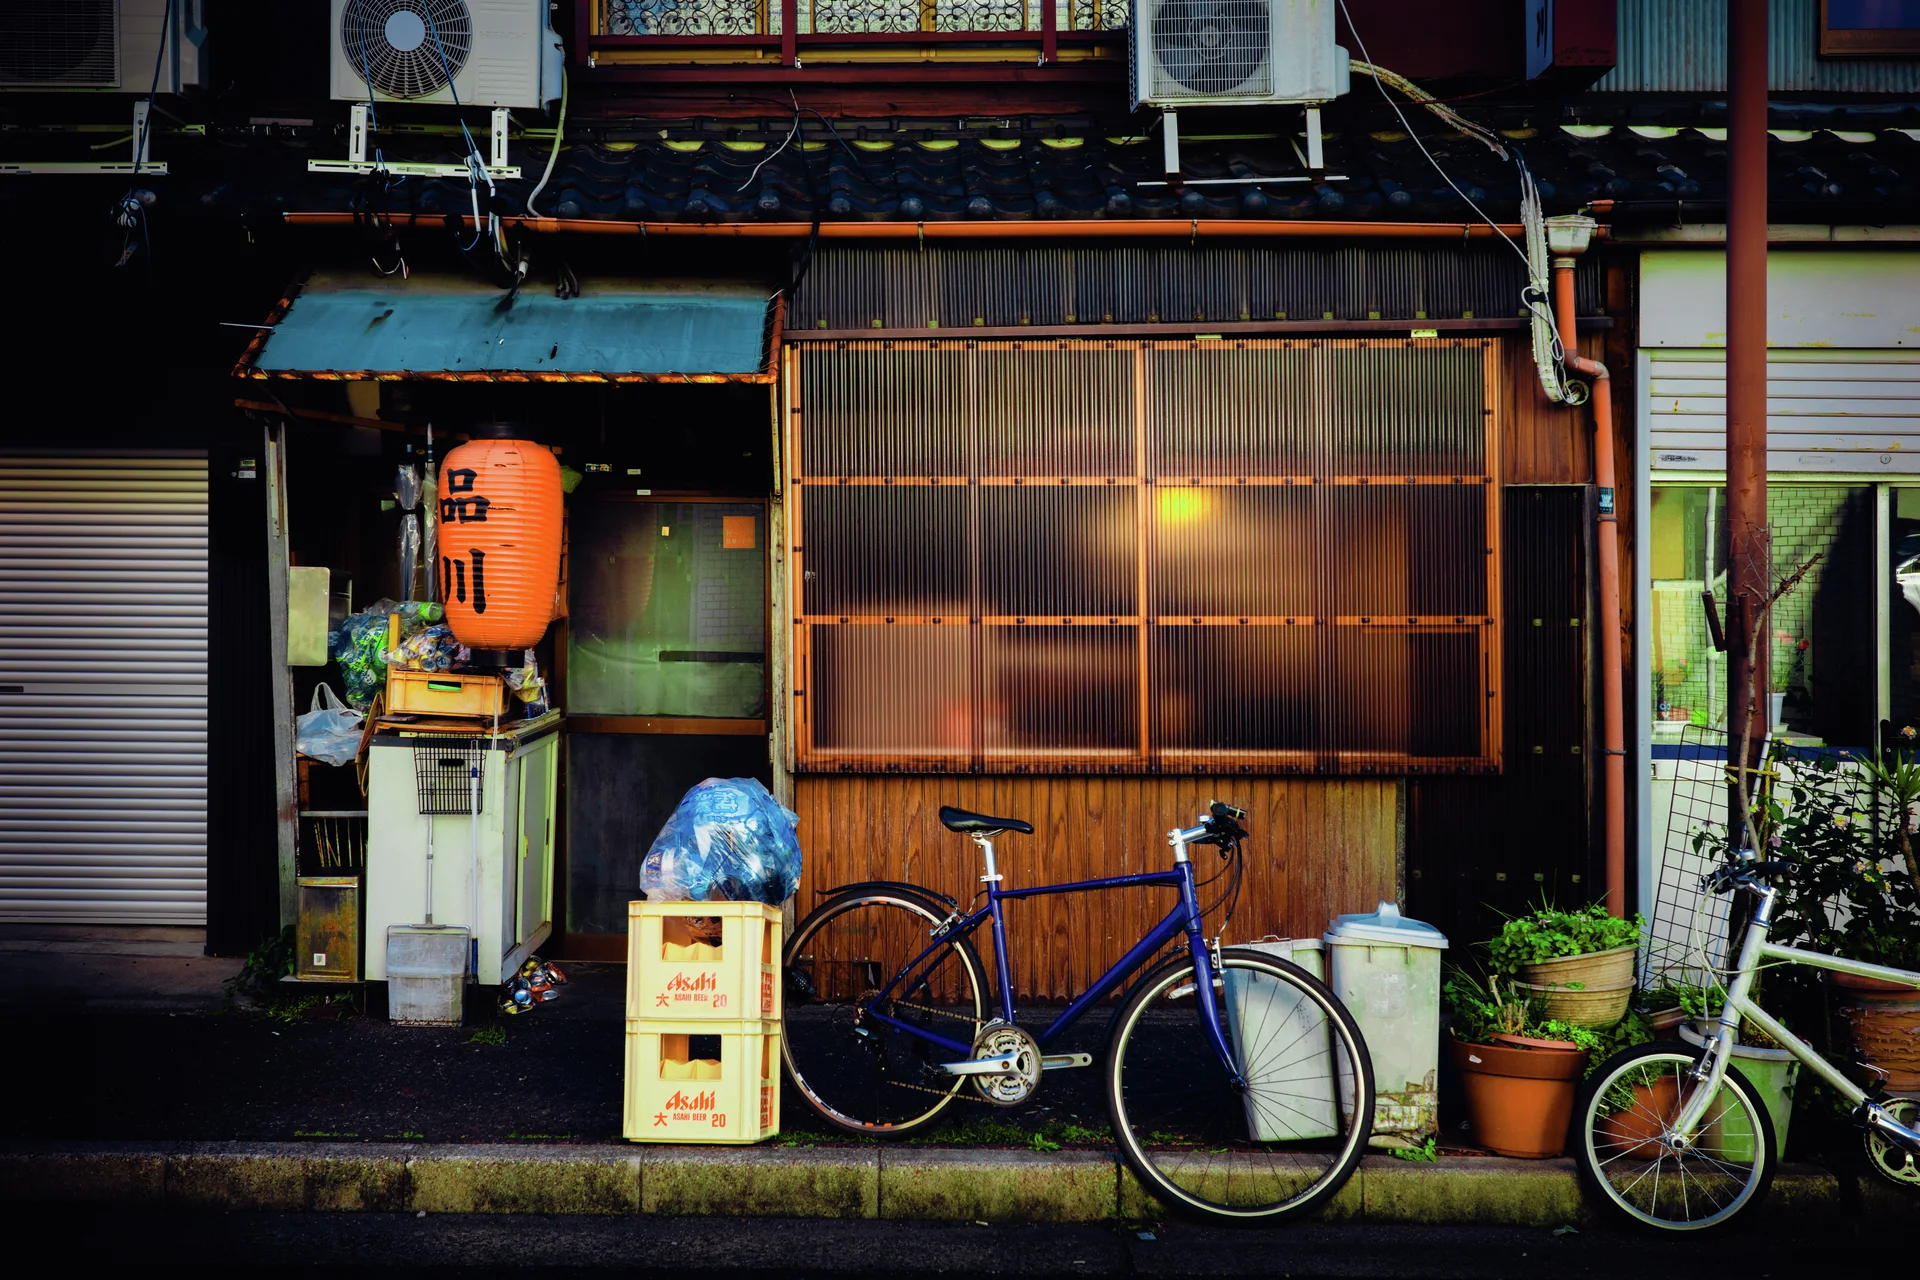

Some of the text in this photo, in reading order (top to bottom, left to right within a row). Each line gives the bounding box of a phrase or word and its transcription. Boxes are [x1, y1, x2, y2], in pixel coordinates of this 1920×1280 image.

[439, 467, 491, 614] 品川
[667, 972, 717, 991] Asahi
[656, 993, 670, 1007] 大
[674, 993, 708, 1001] ASAHI BEER
[712, 994, 728, 1008] 20
[665, 1090, 715, 1111] Asahi
[654, 1112, 668, 1127] 大
[673, 1113, 707, 1121] ASAHI BEER
[711, 1113, 726, 1128] 20
